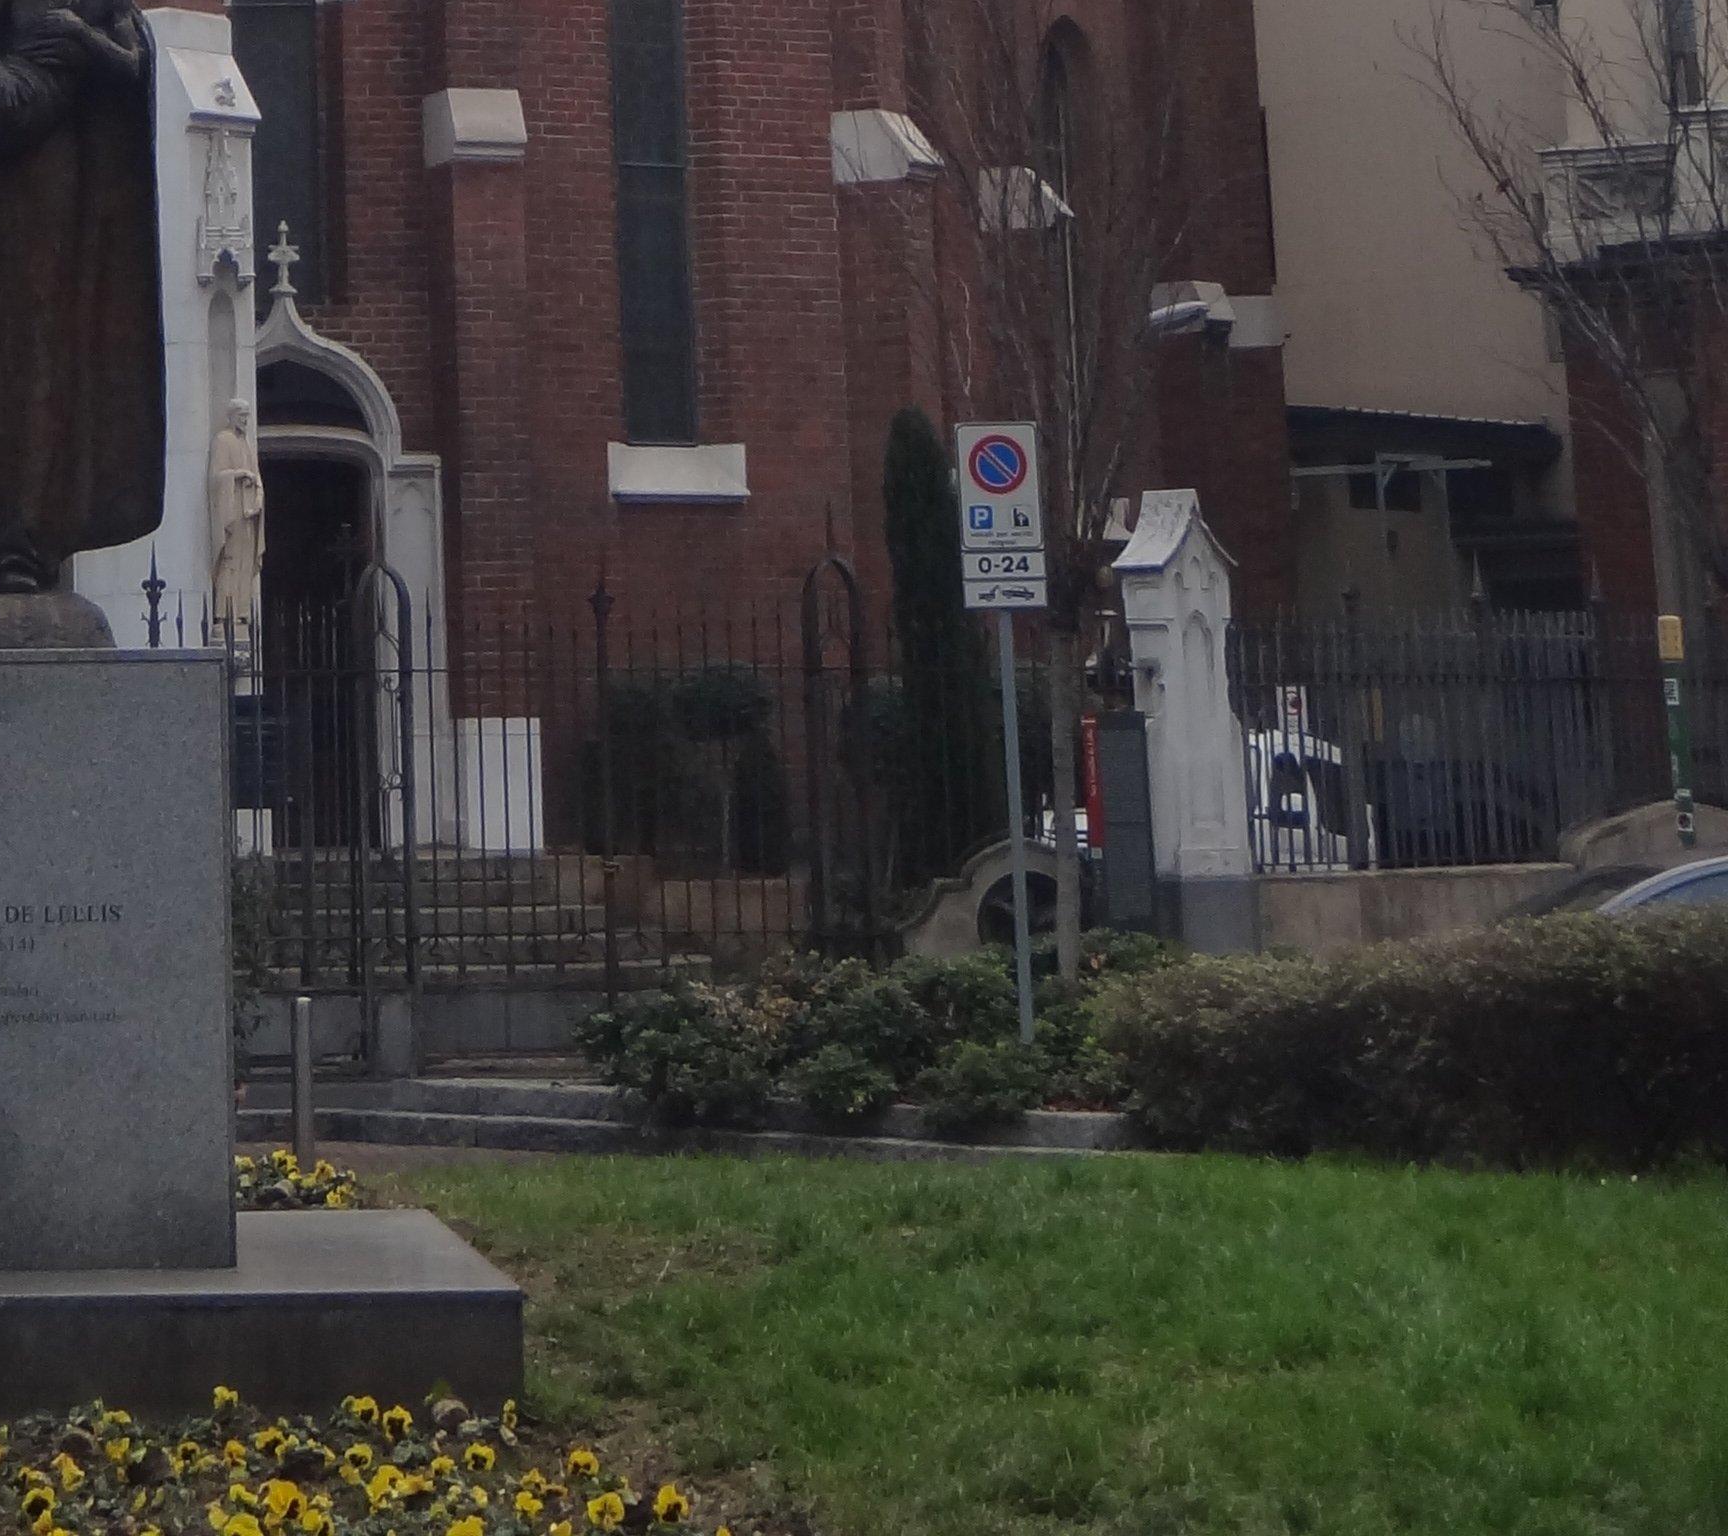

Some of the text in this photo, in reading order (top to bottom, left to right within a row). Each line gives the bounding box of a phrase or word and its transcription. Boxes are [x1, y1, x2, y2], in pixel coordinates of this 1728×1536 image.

[978, 555, 1030, 574] 0-24
[4, 904, 34, 924] DE
[43, 903, 123, 924] LELLIS
